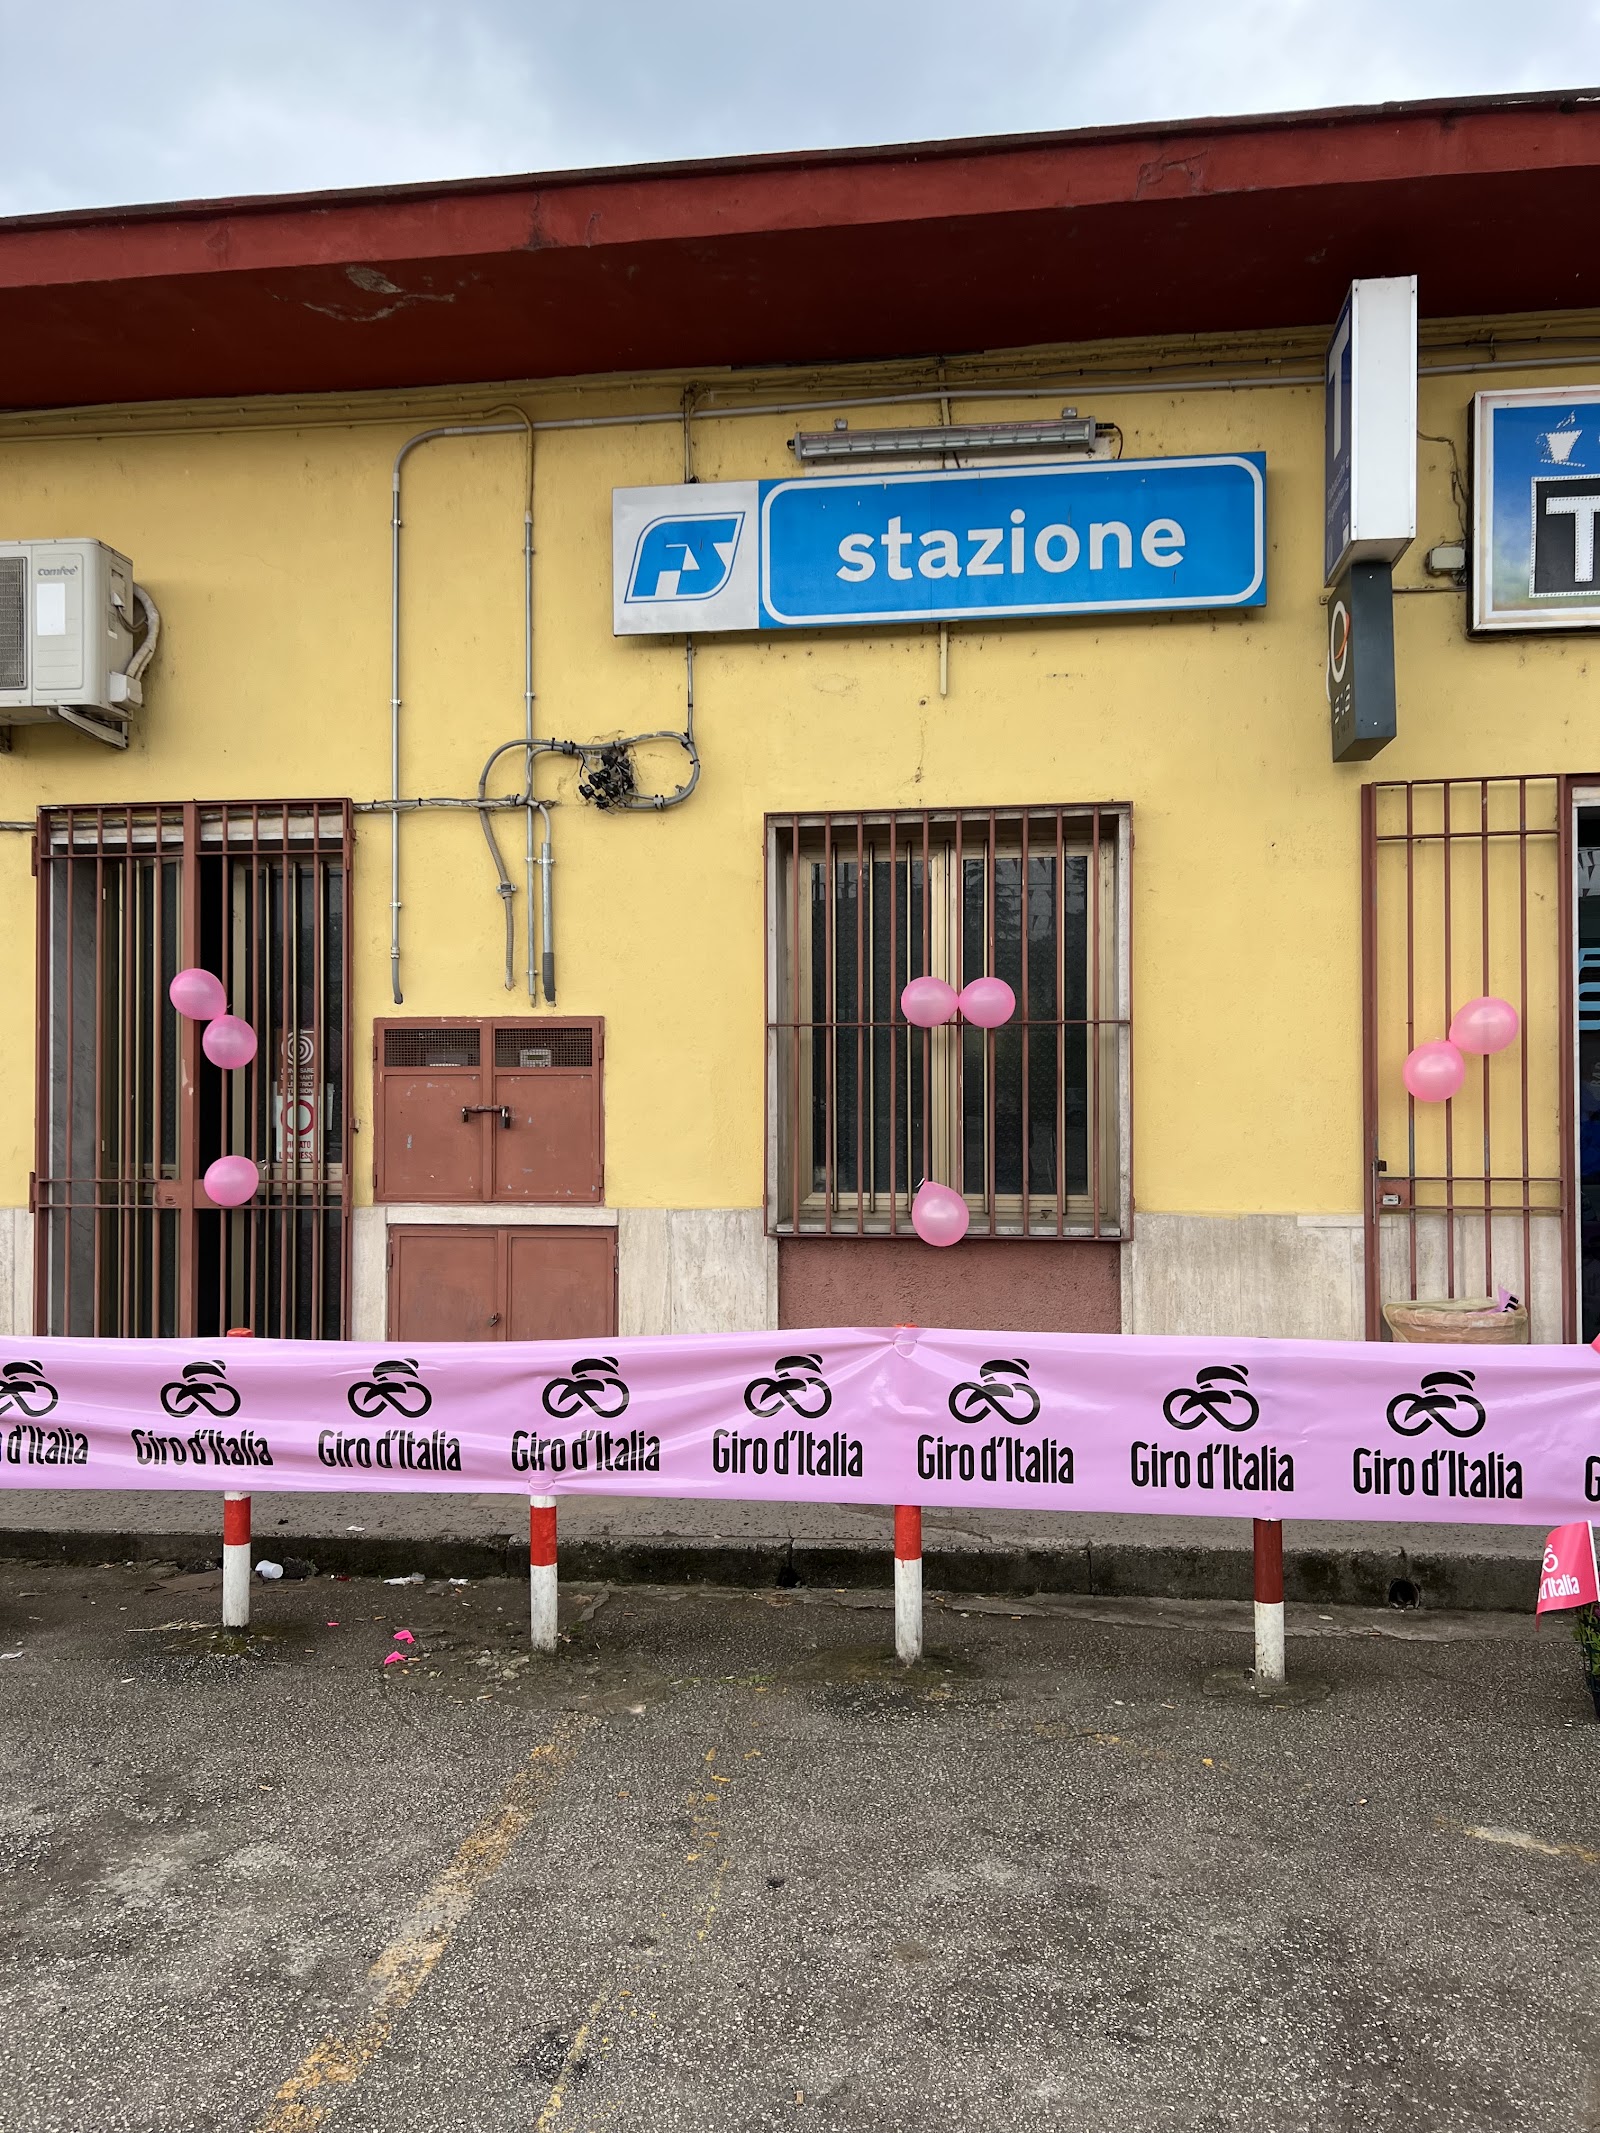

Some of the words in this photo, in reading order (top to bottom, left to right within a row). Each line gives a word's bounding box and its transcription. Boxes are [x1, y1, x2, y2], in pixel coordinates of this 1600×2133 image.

[836, 508, 1187, 584] stazione
[38, 566, 77, 576] comfee
[7, 1425, 88, 1465] d'Italia
[131, 1429, 187, 1463] Giro
[188, 1431, 274, 1466] d'Italia
[318, 1430, 373, 1469] Giro
[376, 1430, 462, 1472] d'Italia
[511, 1431, 567, 1472] Giro
[571, 1430, 660, 1472] d'Italia
[713, 1430, 768, 1475] Giro
[775, 1431, 863, 1477] d'Italia
[918, 1435, 975, 1481] Giro
[981, 1437, 1074, 1484] d'Italia
[1131, 1442, 1191, 1489] Giro
[1198, 1444, 1294, 1492] d'Italia
[1353, 1447, 1415, 1496] Giro
[1422, 1449, 1523, 1499] d'Italia
